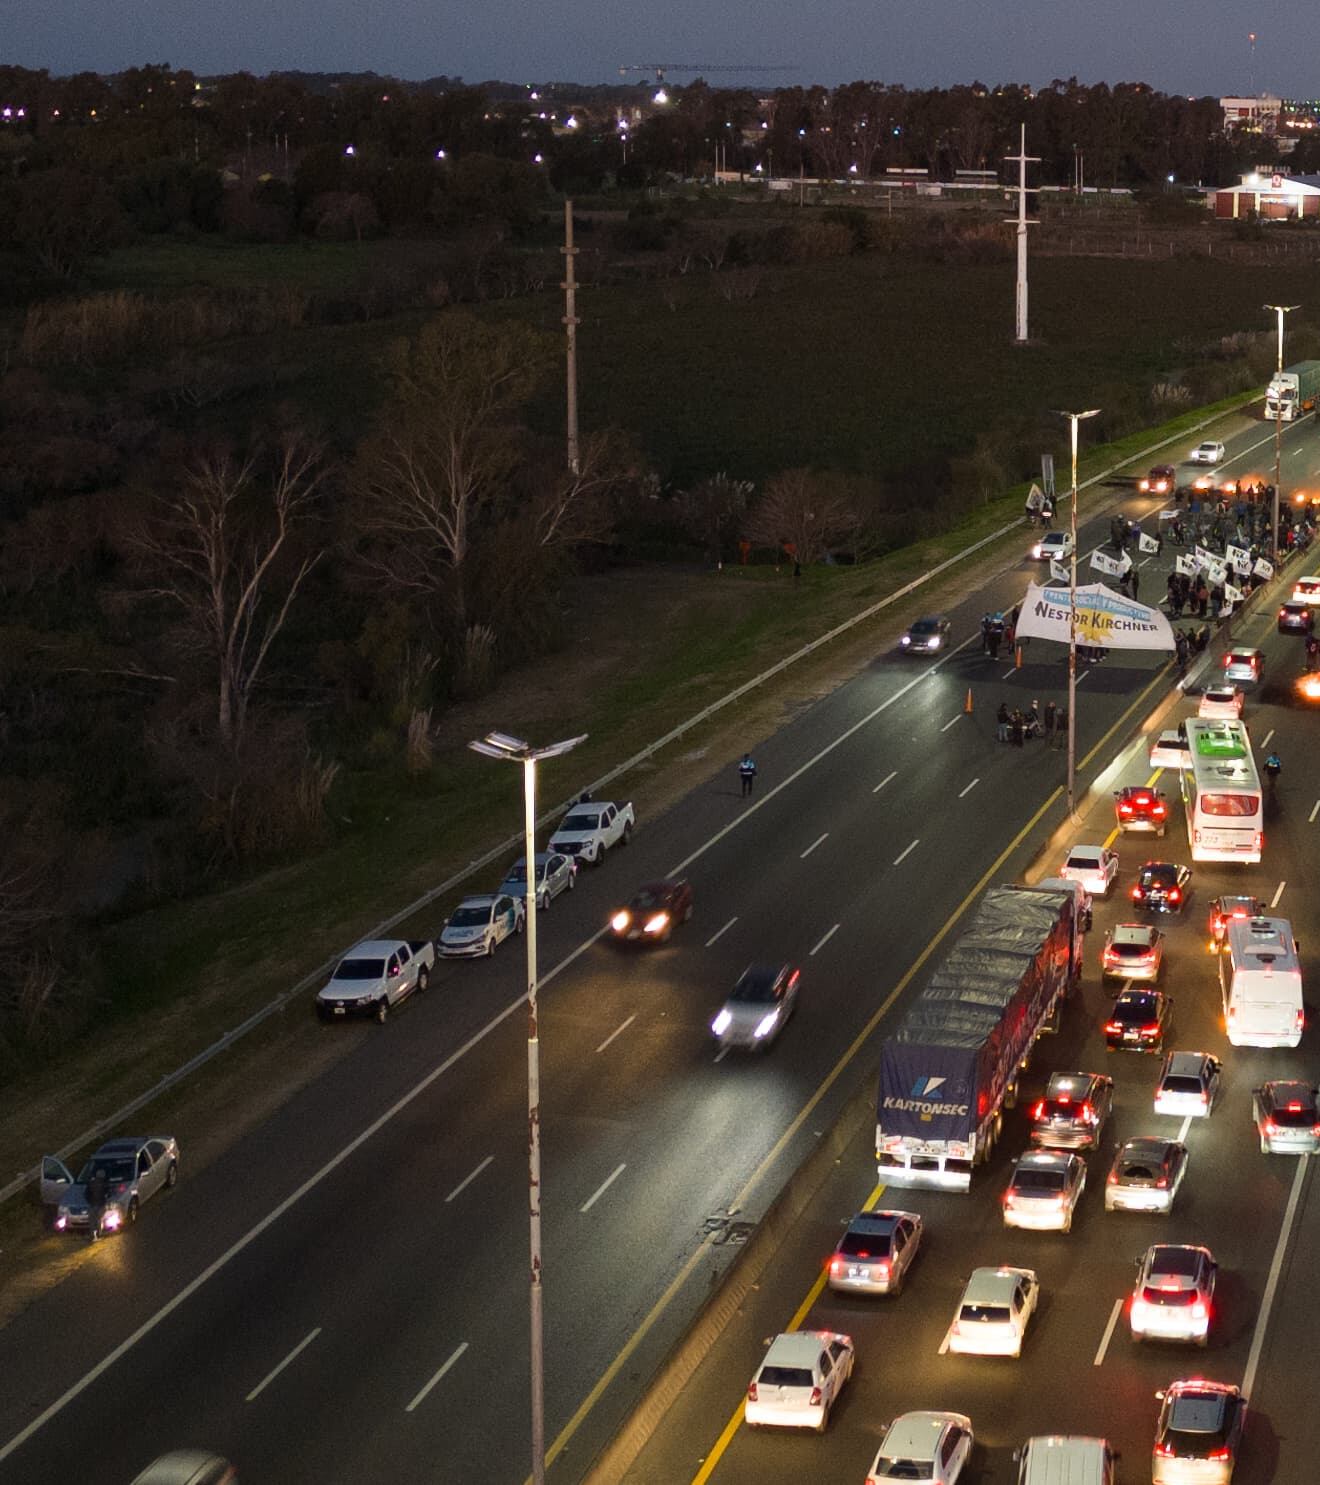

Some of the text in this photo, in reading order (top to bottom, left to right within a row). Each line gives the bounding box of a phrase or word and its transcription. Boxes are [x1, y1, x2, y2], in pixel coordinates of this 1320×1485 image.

[1035, 601, 1088, 625] NESTOR
[1091, 612, 1158, 631] KIRCHNER
[883, 1097, 968, 1116] KARTONSEC
